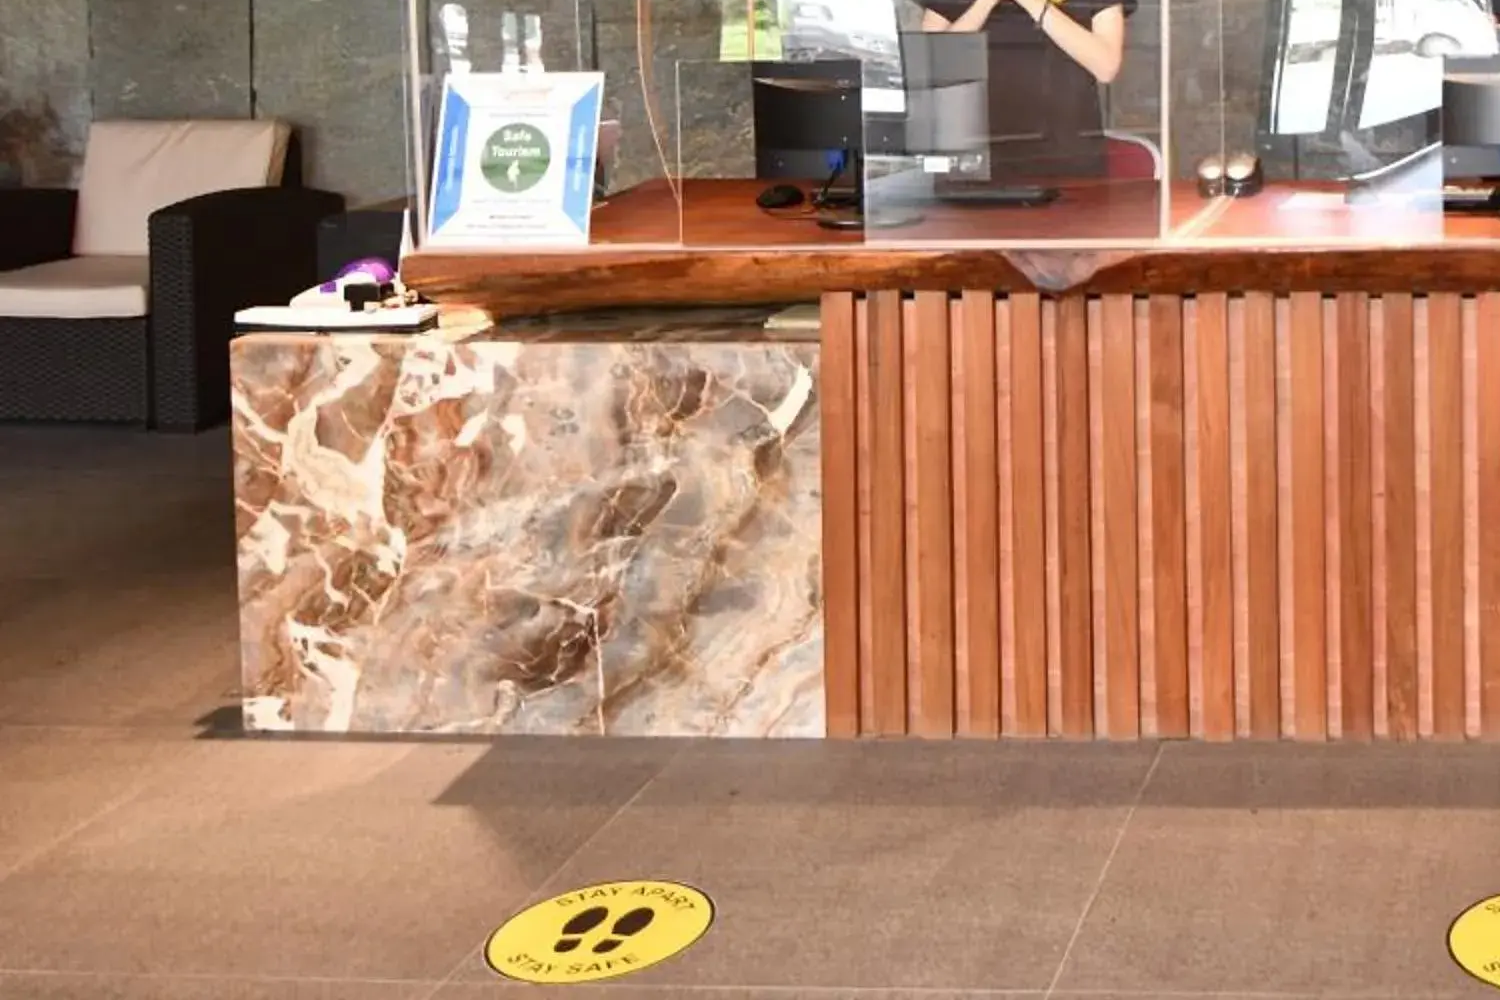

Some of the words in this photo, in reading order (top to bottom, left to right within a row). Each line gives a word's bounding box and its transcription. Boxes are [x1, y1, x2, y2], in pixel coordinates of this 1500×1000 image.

[502, 129, 532, 142] Safe
[491, 145, 541, 158] Tourism
[555, 886, 623, 908] STAY
[631, 886, 696, 911] APART
[506, 952, 558, 976] STAY
[565, 952, 641, 975] SAFE
